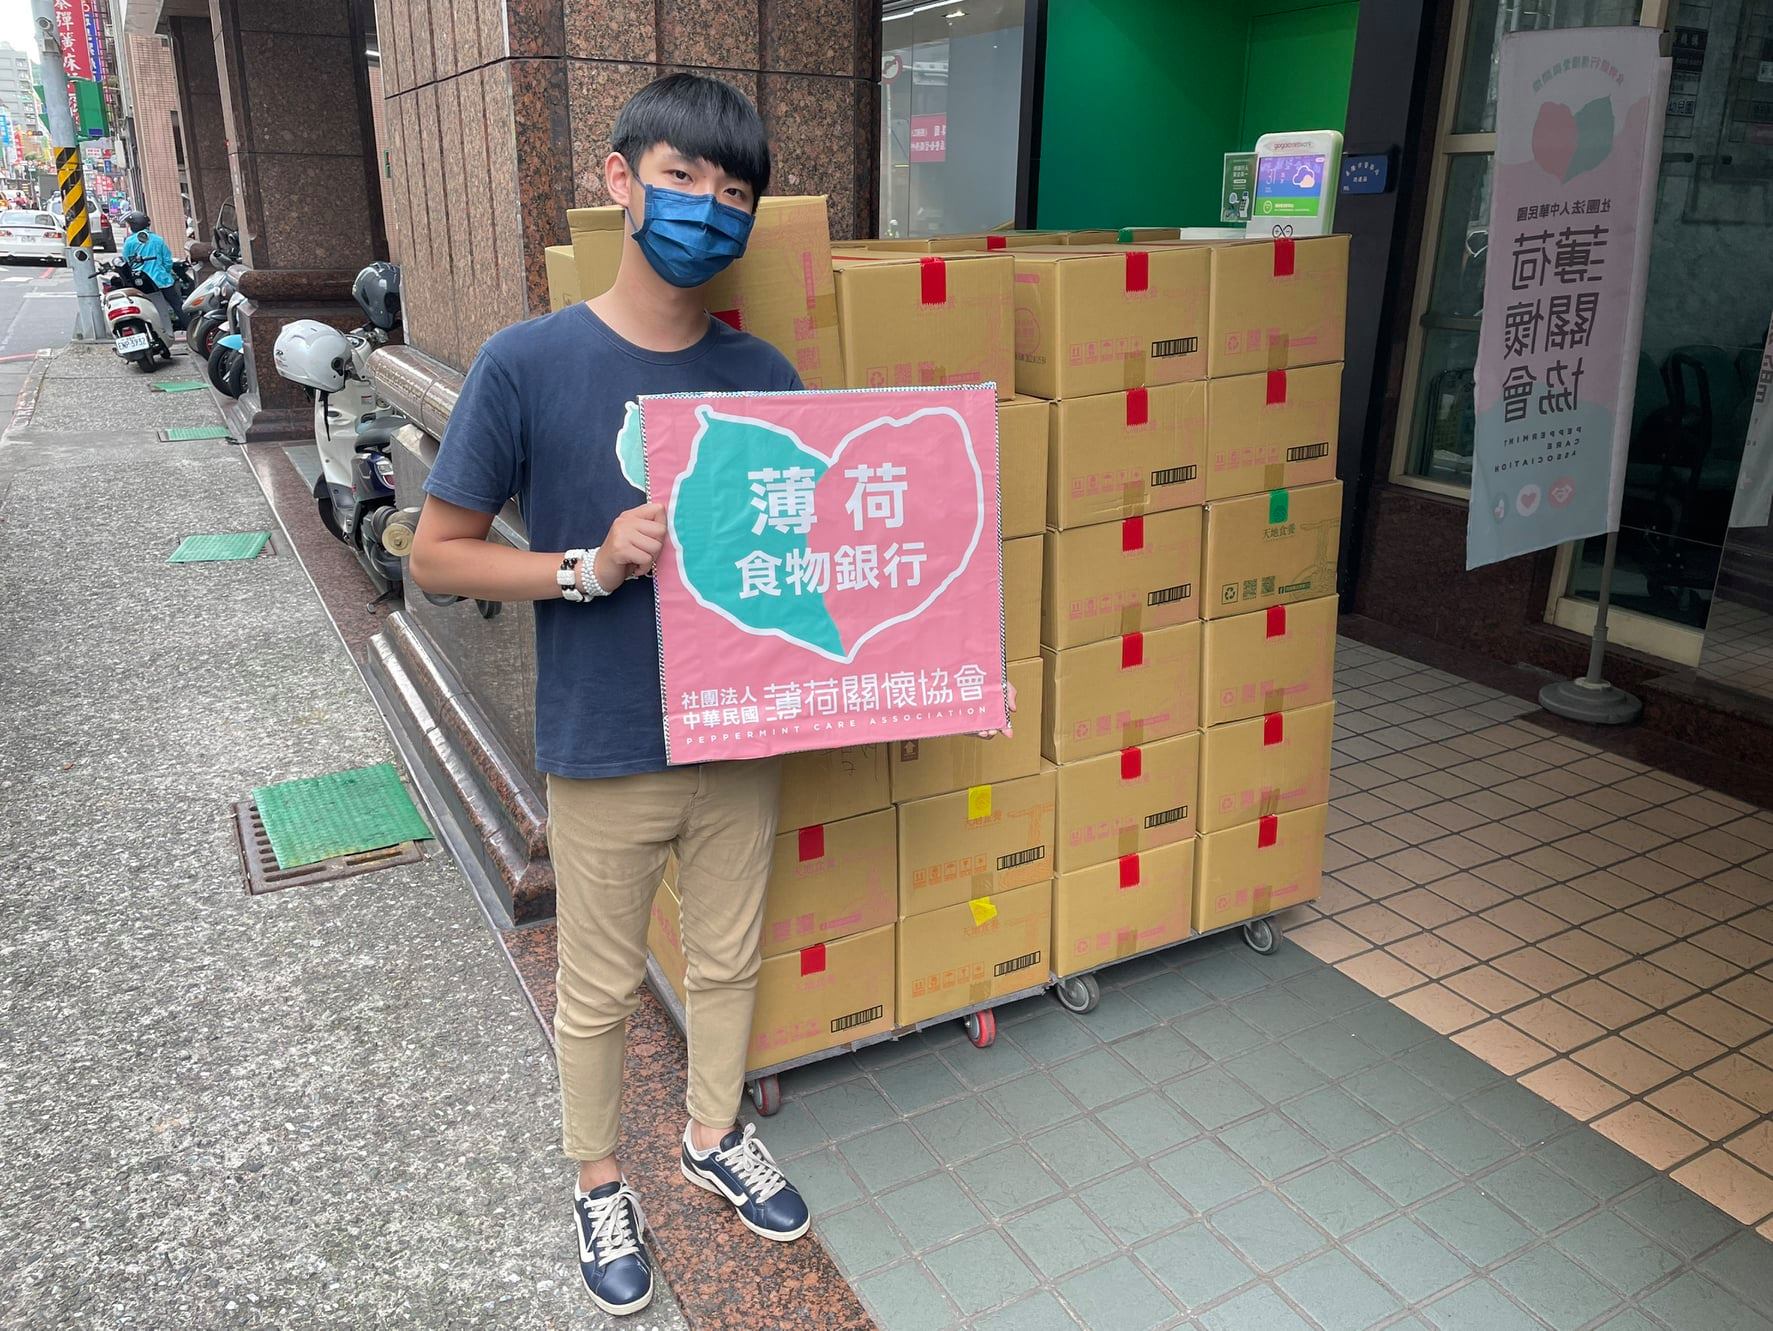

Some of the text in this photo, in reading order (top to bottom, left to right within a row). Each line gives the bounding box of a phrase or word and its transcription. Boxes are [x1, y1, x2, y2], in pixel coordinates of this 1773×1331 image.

[747, 462, 908, 536] 薄荷
[734, 542, 928, 600] 食物銀行
[681, 686, 758, 711] 社團法人
[763, 663, 987, 722] 薄荷關懷協會
[682, 706, 760, 731] 中華民國
[686, 705, 987, 745] PEPPERMINT CARE ASSOCIATION
